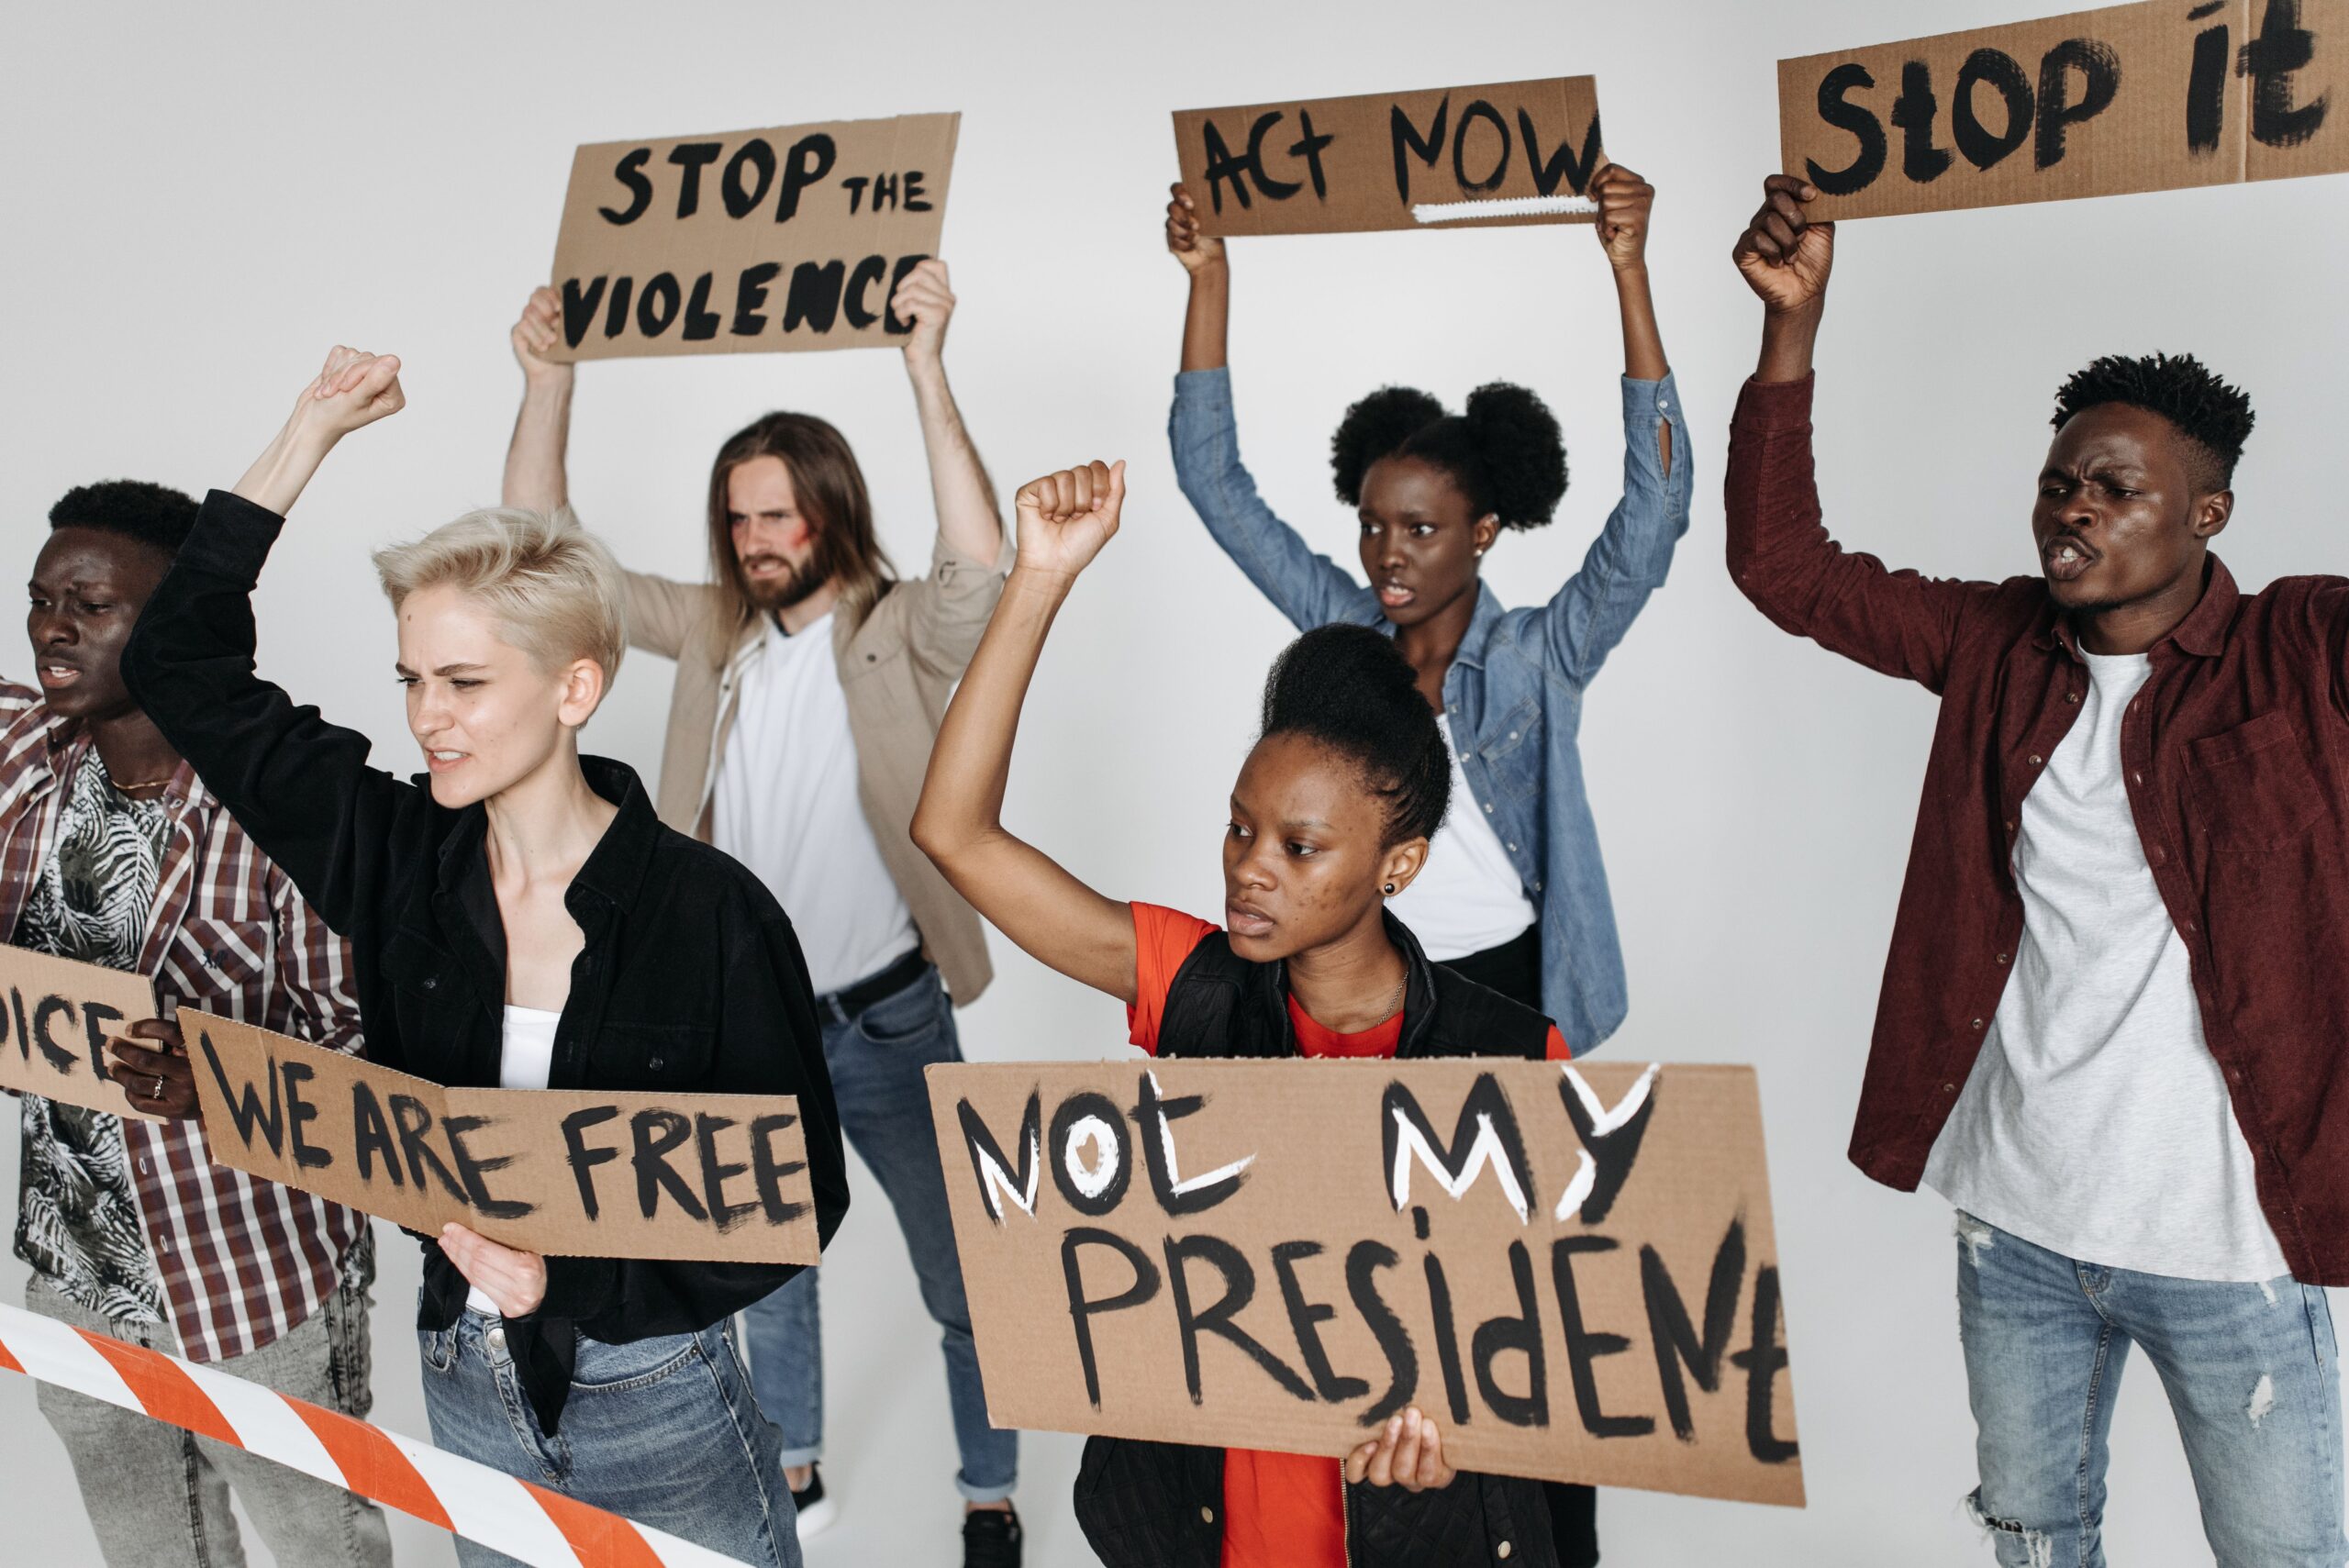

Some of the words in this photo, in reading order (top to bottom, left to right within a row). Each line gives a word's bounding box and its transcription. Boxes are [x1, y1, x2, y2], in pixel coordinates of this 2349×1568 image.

[598, 132, 837, 226] STOP
[841, 170, 934, 216] THE
[1390, 89, 1602, 207] NOW
[200, 1029, 334, 1169] WE
[351, 1080, 541, 1220] ARE
[561, 1104, 818, 1236] FREE
[1381, 1062, 1663, 1226] MY
